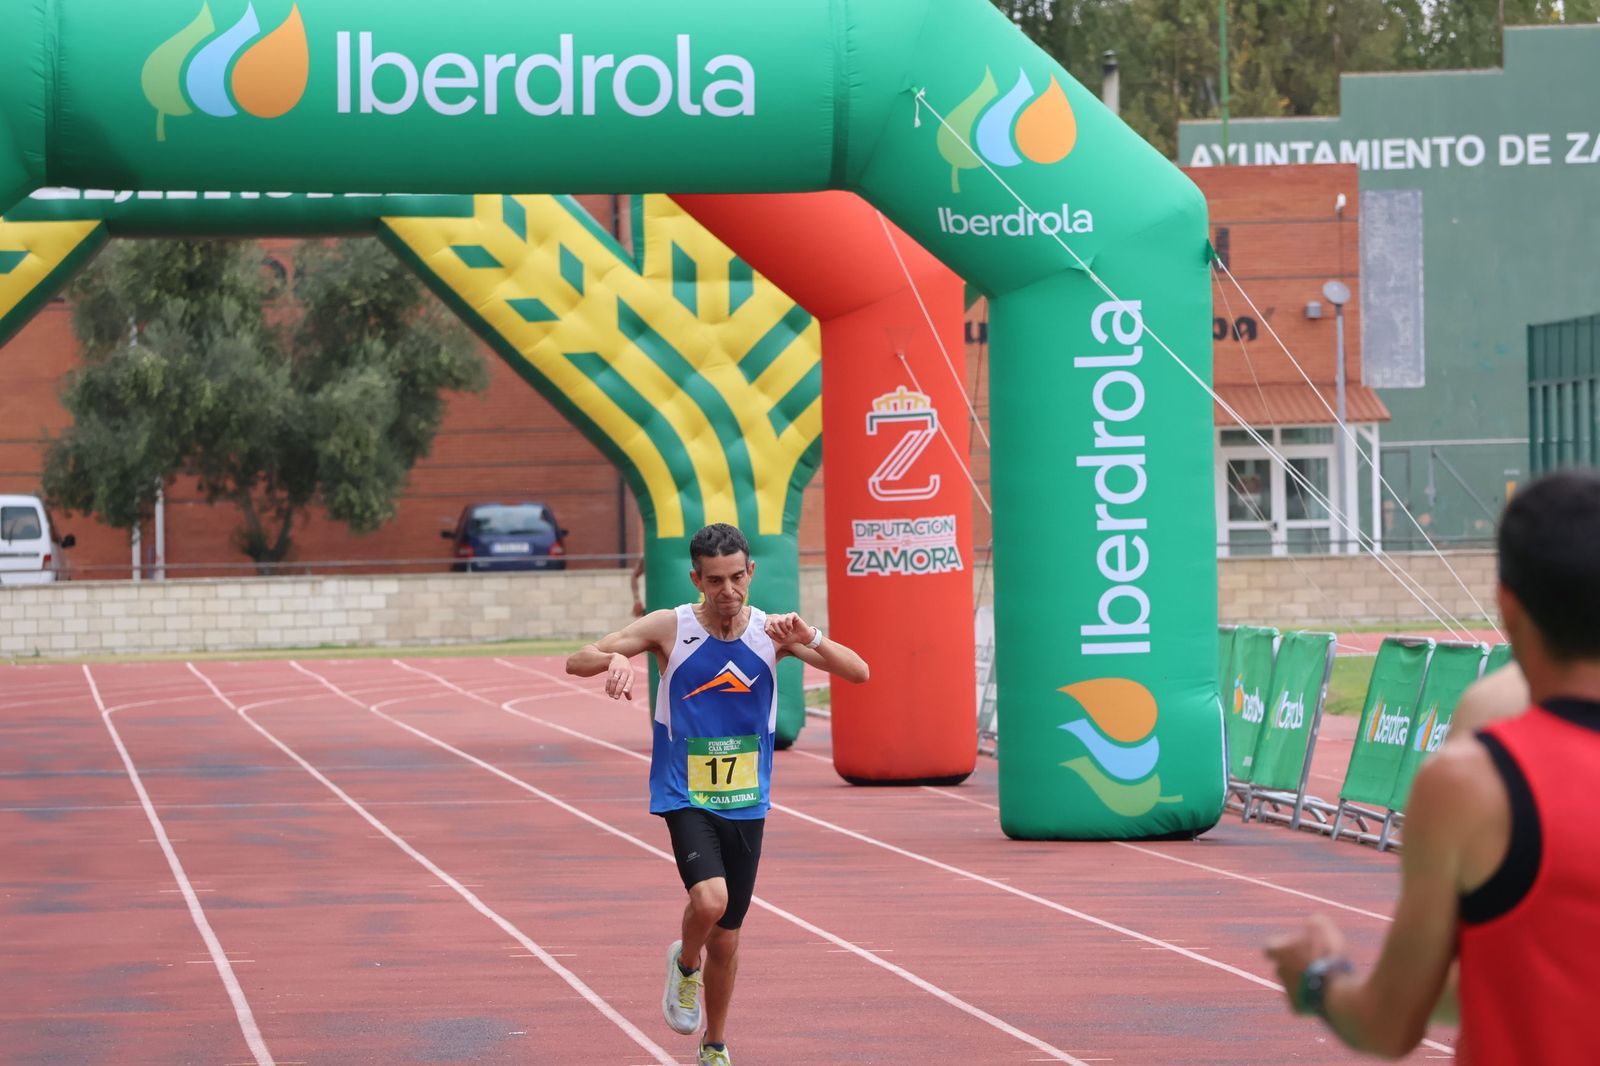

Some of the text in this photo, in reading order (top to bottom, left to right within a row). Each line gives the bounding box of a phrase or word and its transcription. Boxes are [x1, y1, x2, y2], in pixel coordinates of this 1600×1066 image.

[336, 31, 756, 118] Iberdrola
[1190, 135, 1485, 170] AYUNTAMIENTO
[1499, 134, 1551, 165] DE
[937, 203, 1094, 236] Iberdrola
[1074, 300, 1151, 655] Iberdrola
[848, 546, 961, 573] ZAMORA
[705, 757, 737, 785] 17
[710, 792, 757, 804] CAJA RURAL
